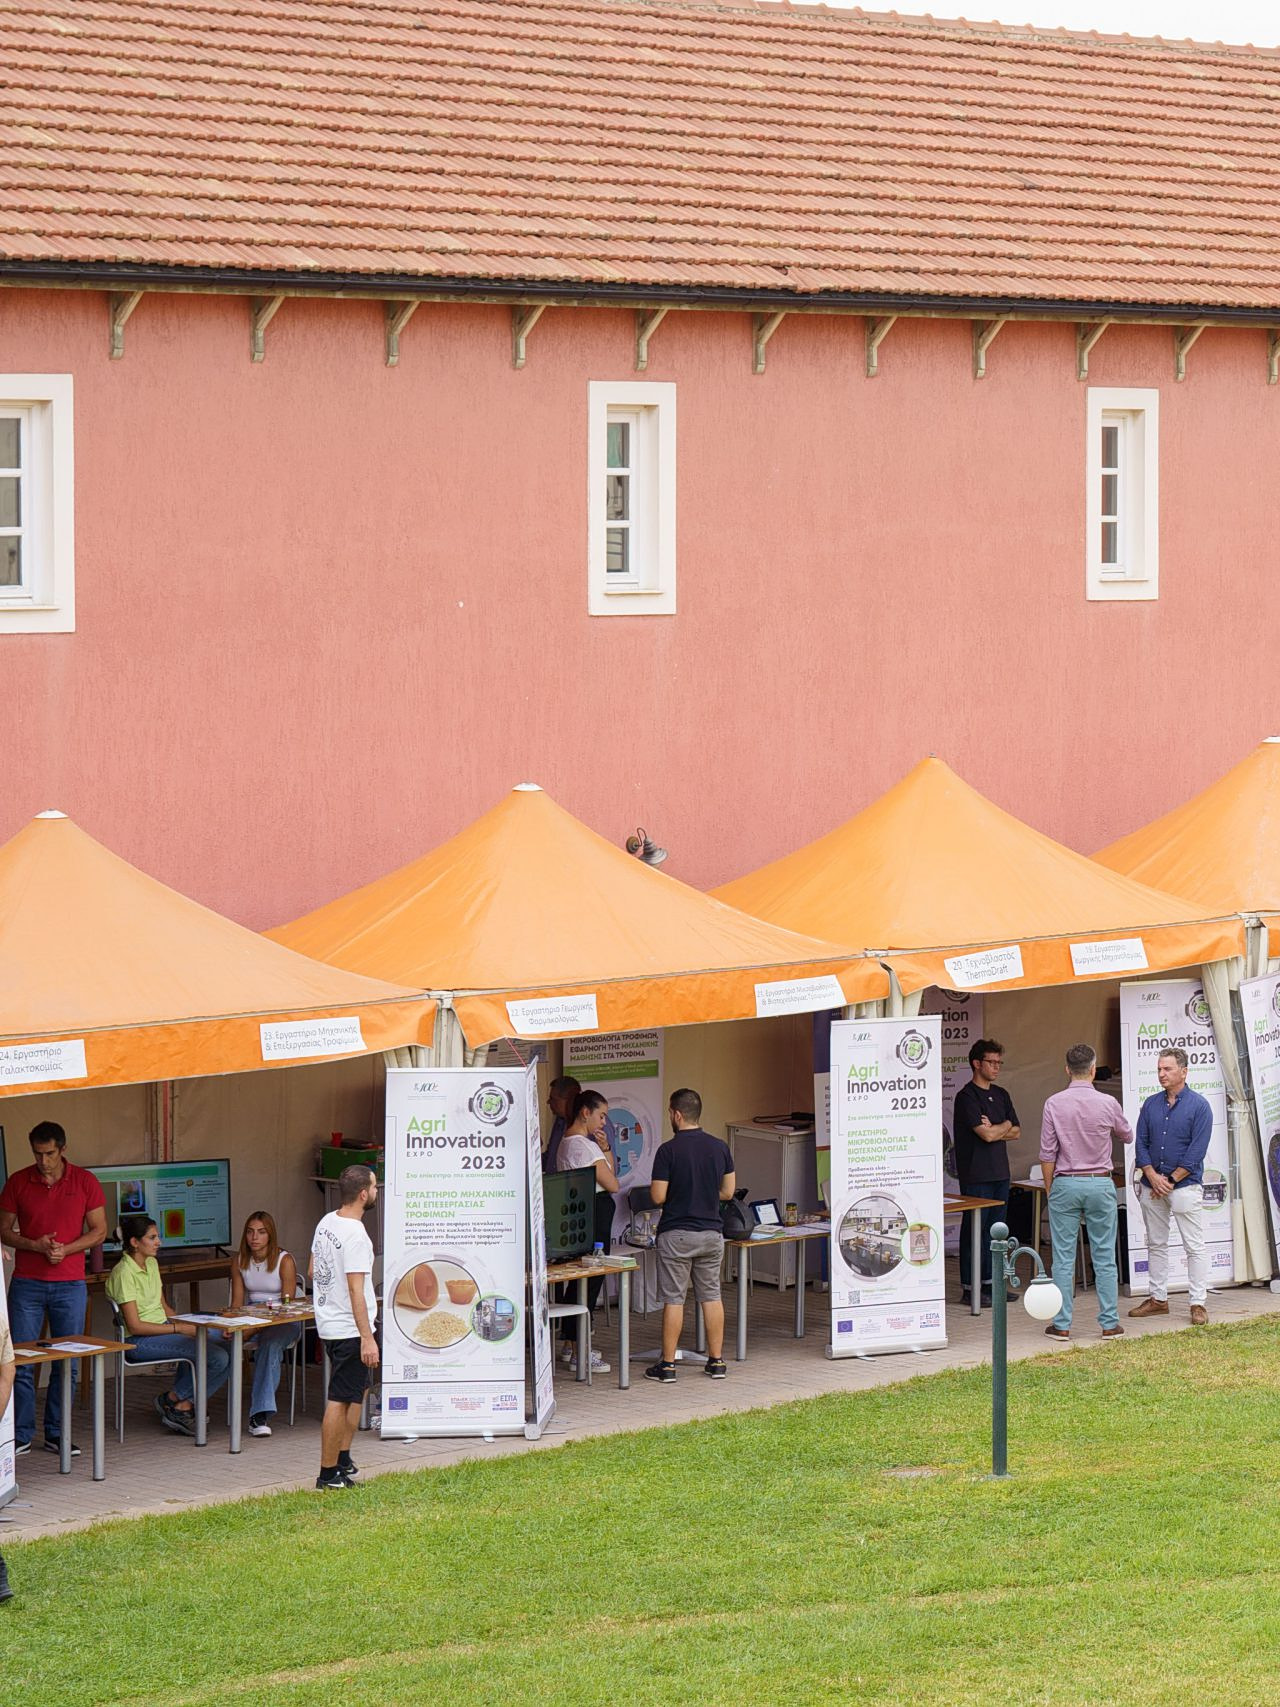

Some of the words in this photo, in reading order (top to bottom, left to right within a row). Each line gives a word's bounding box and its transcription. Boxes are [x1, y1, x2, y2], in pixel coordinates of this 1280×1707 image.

[1137, 1019, 1168, 1038] Agri
[1254, 1014, 1268, 1034] Agri
[570, 1034, 621, 1044] ΜΙΚΡΟΒΙΟΛΟΓΙΑ
[941, 1028, 969, 1040] 023
[1137, 1032, 1216, 1050] Innovation
[14, 1048, 62, 1060] Εργαστήριο
[570, 1044, 606, 1053] ΕΦΑΡΜΟΓΗ
[1190, 1052, 1216, 1064] 023
[847, 1061, 879, 1082] Agri
[847, 1075, 926, 1094] Innovation
[1189, 1081, 1223, 1090] ΕΩΡΓΙΚΗΣ
[891, 1097, 927, 1110] 2023
[407, 1114, 446, 1135] Agri
[848, 1128, 888, 1137] ΕΡΓΑΣΤΗΡΙΟ
[406, 1131, 506, 1149] Innovation
[848, 1136, 908, 1146] ΜΙΚΡΟΒΙΟΛΟΓΙΑΣ
[848, 1145, 908, 1155] ΒΙΟΤΕΧΝΟΛΟΓΙΑΣ
[461, 1156, 506, 1170] 2023
[848, 1155, 886, 1163] ΤΡΟΦΙΜΩΝ
[405, 1191, 458, 1199] ΕΡΓΑΣΤΗΡΙΟ
[460, 1190, 516, 1198] ΜΗΧΑΝΙΚΗΣ
[423, 1200, 485, 1208] ΕΠΕΞΕΡΓΑΣΙΑΣ
